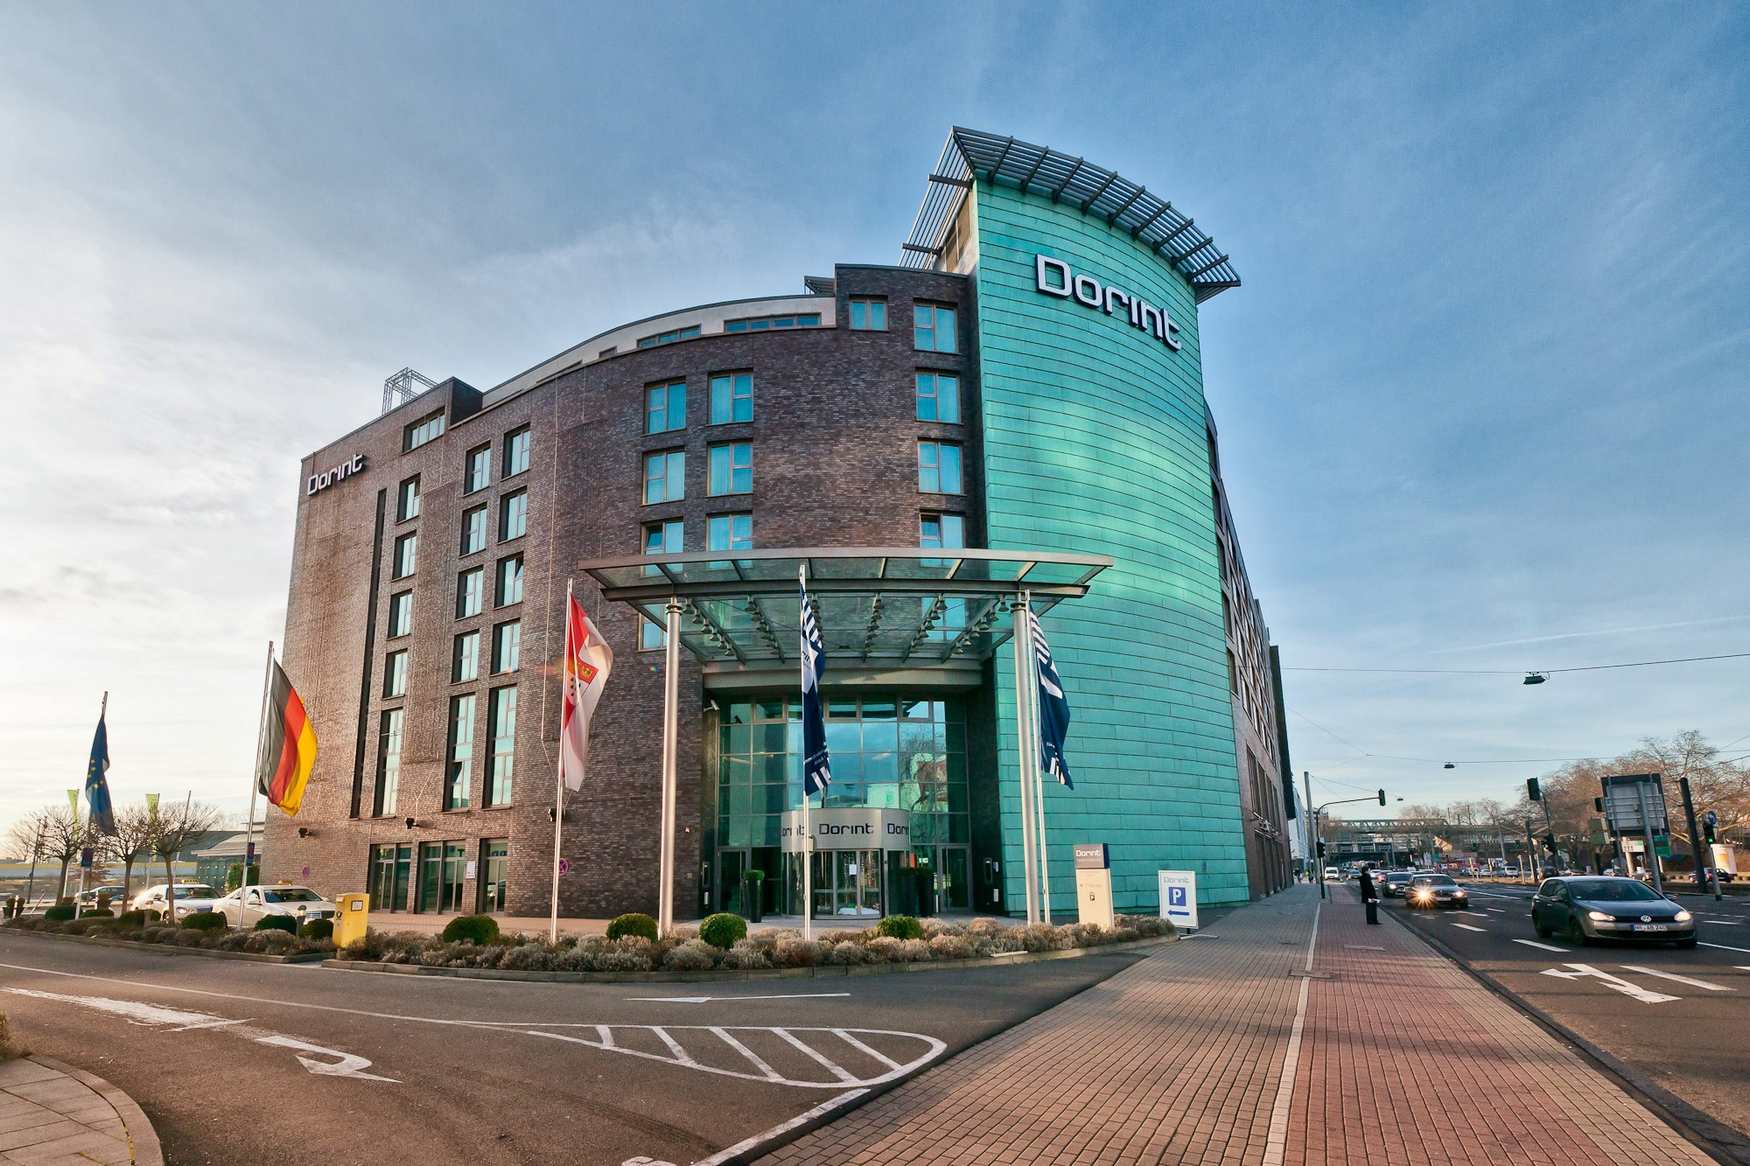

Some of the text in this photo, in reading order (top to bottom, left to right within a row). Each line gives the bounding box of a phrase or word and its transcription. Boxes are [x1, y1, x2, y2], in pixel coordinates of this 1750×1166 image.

[1036, 254, 1182, 351] Dorint
[307, 454, 364, 496] Dorint
[819, 823, 874, 835] Dorint
[1172, 888, 1182, 904] P
